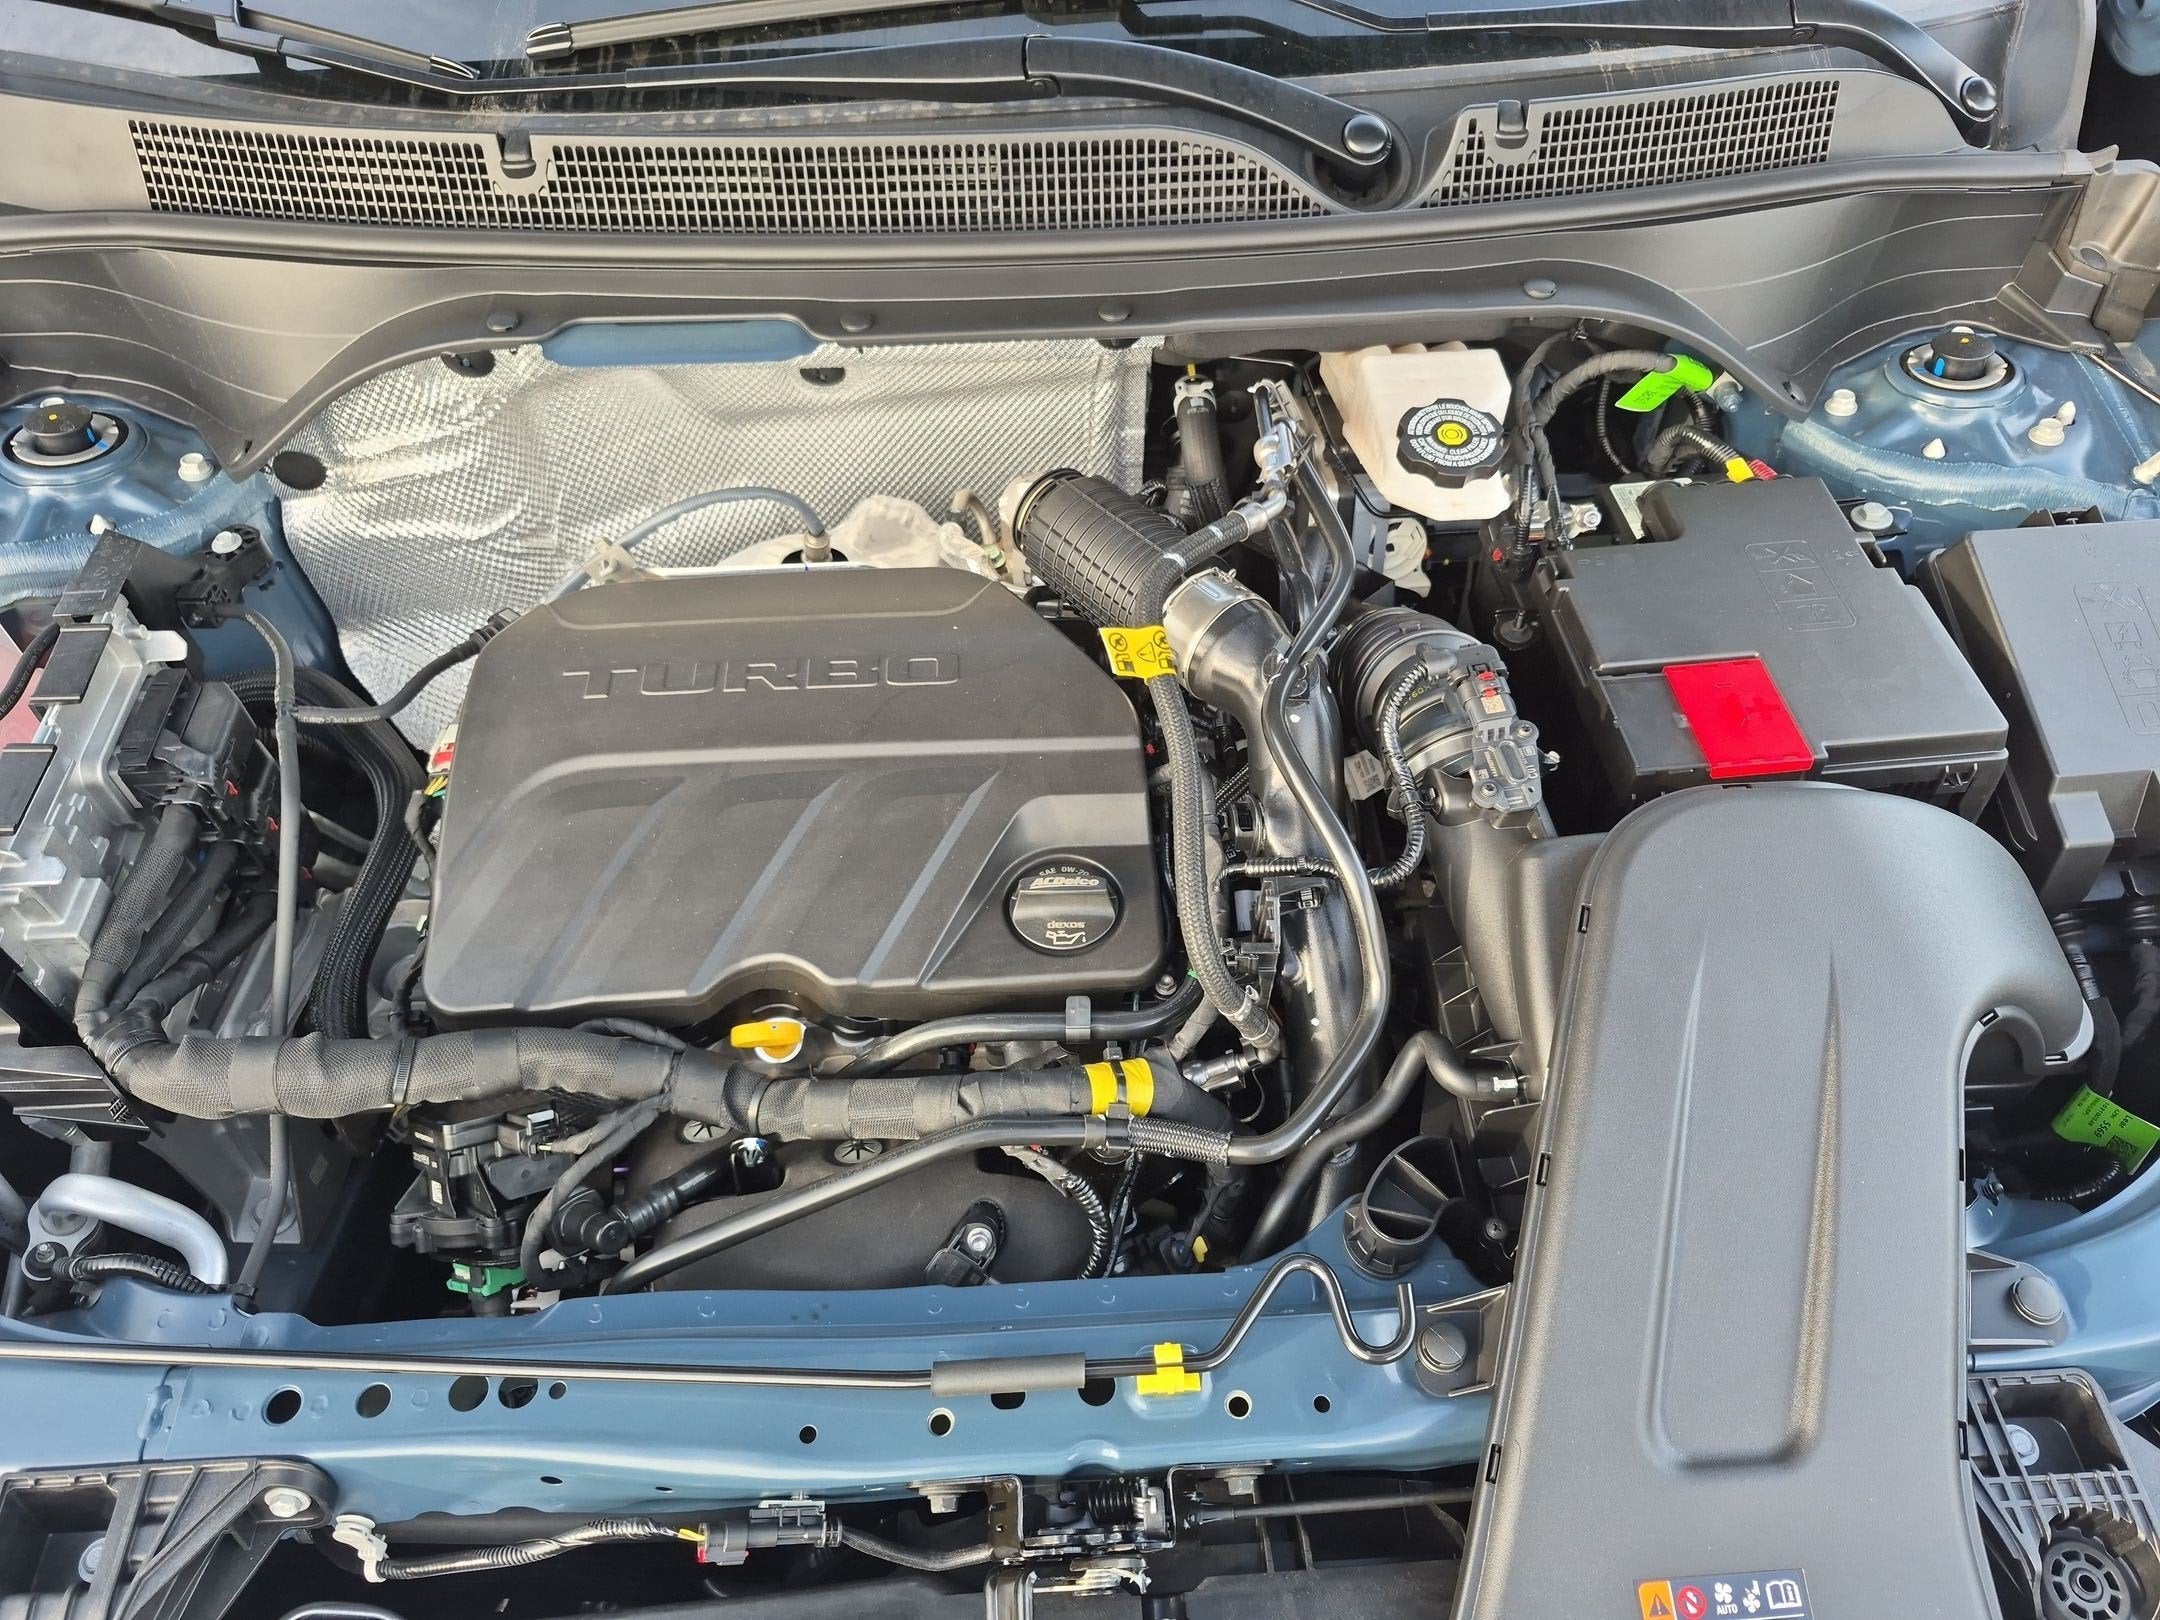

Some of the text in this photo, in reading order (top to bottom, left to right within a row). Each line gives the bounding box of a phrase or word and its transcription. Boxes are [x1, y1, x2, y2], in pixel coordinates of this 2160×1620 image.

[1432, 456, 1452, 466] FROM
[563, 653, 960, 700] TURBO
[1029, 876, 1100, 889] ACDelco
[1047, 920, 1086, 929] dexos
[2094, 1120, 2112, 1138] 5569
[1716, 1604, 1739, 1616] AUTO
